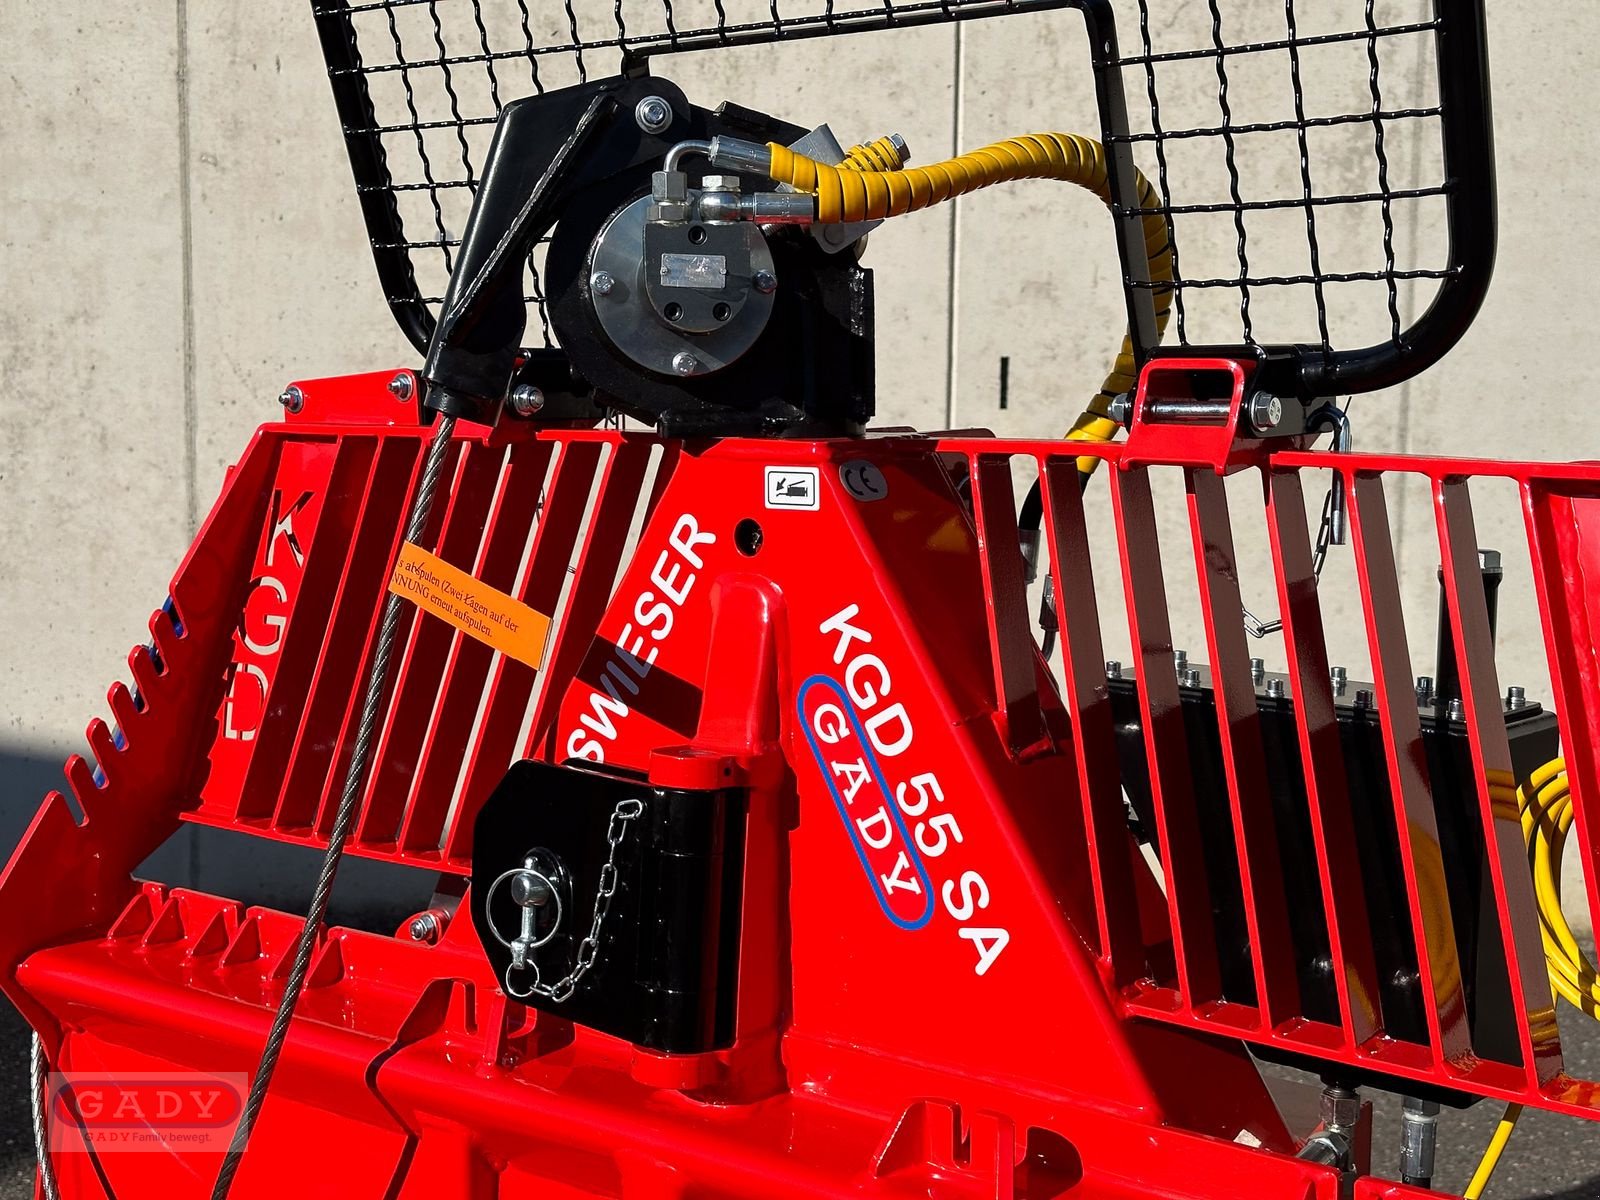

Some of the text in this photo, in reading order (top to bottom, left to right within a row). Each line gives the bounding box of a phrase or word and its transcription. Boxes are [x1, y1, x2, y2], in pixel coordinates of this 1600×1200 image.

[430, 593, 453, 614] erneut
[453, 608, 493, 638] aufspulen.
[489, 610, 505, 625] auf
[504, 617, 519, 633] der
[813, 703, 921, 895] GADY
[819, 603, 1010, 976] KGD 55 SA
